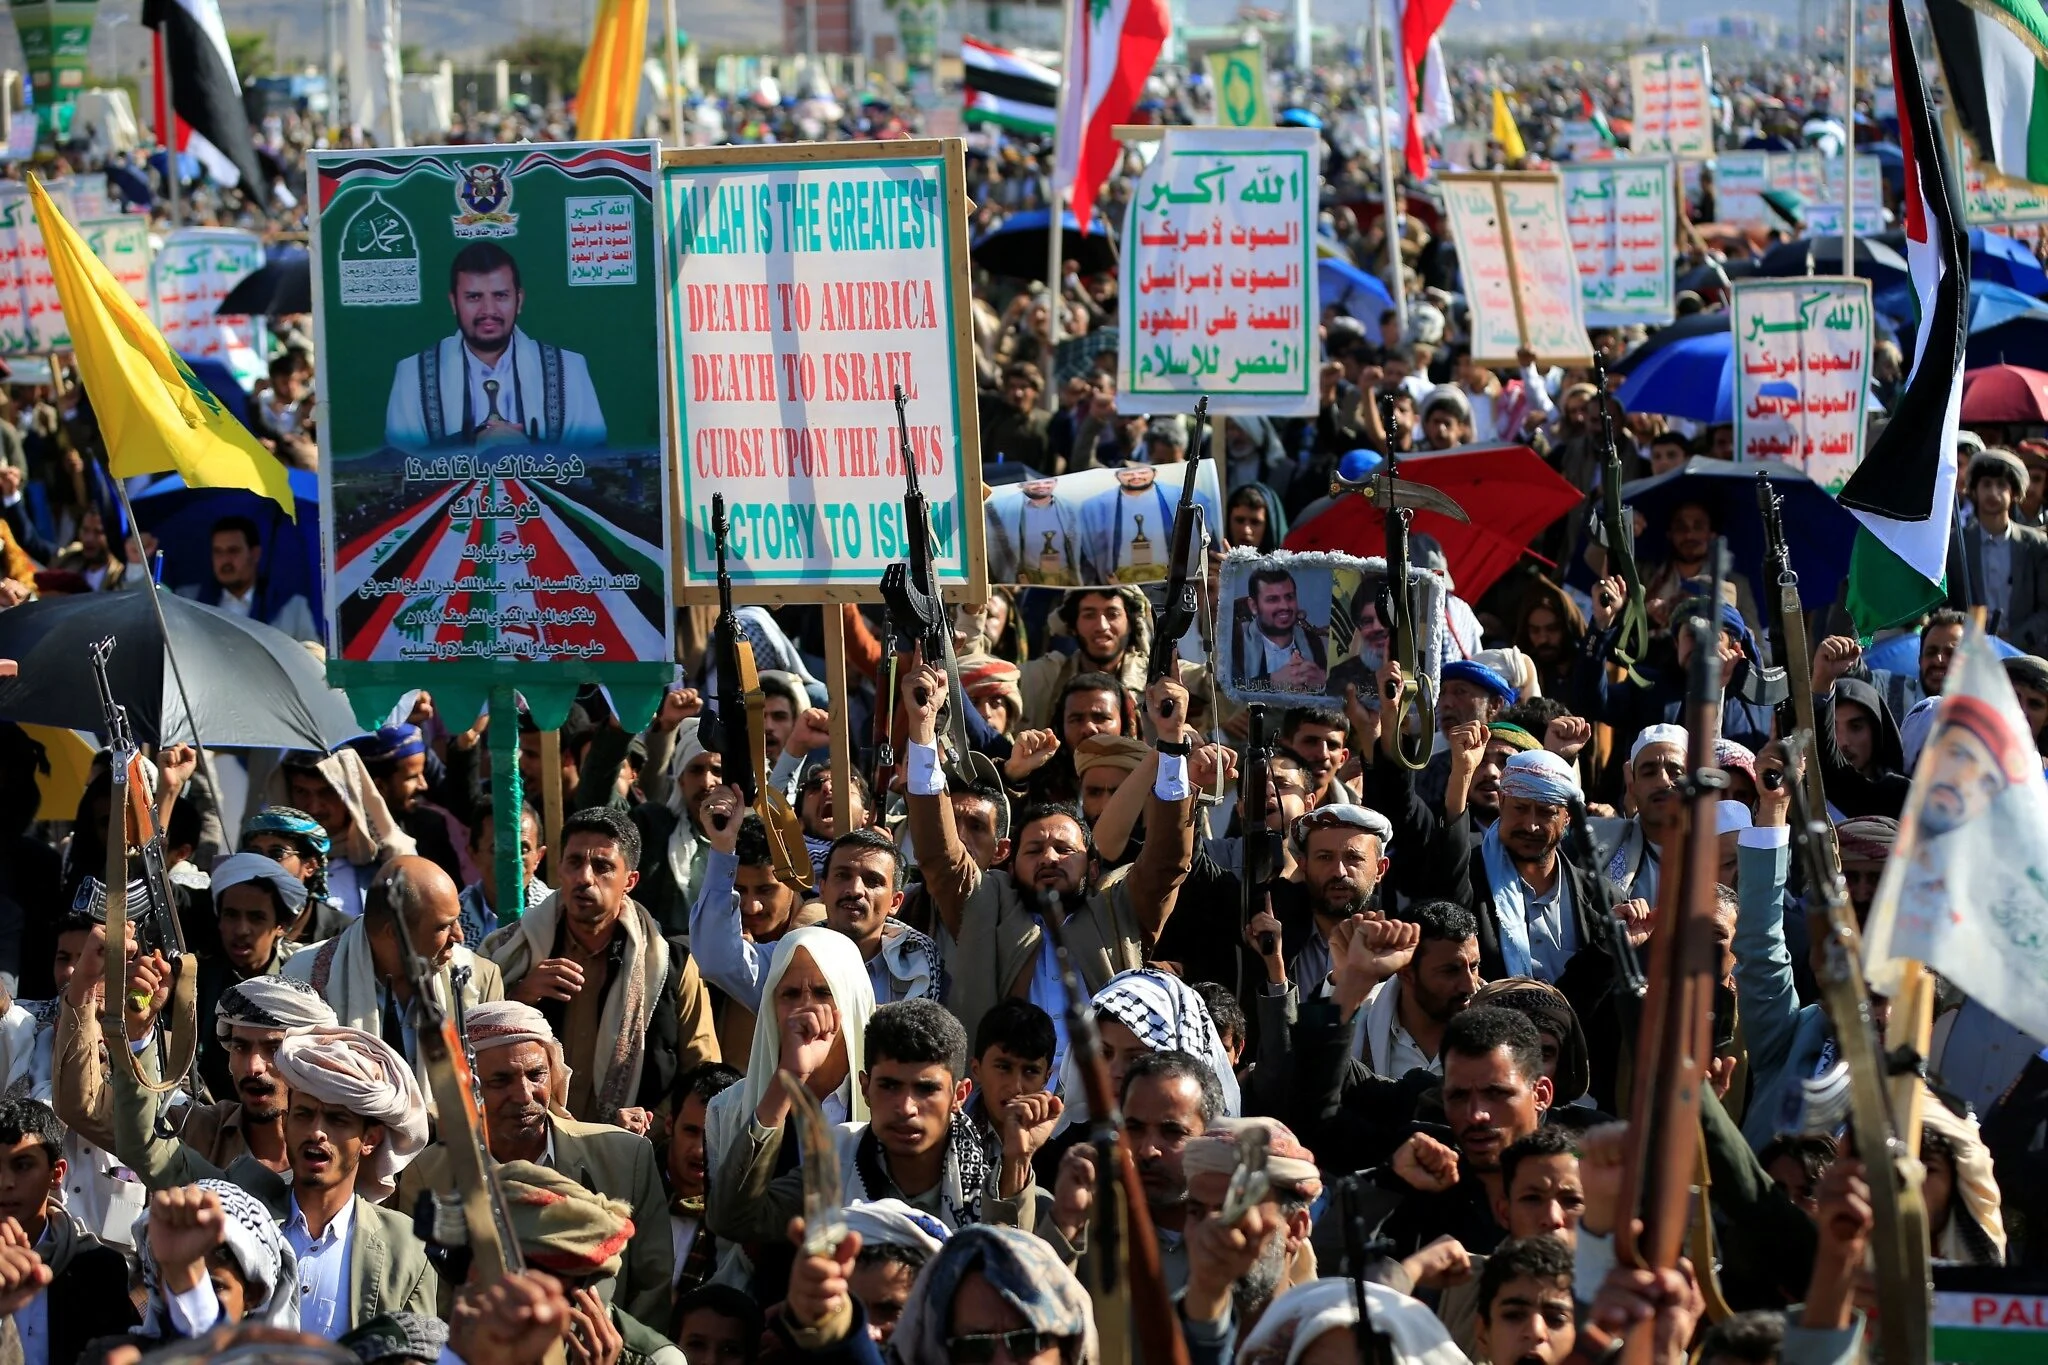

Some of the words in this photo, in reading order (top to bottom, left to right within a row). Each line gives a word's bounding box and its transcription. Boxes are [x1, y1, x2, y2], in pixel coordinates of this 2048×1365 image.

[1140, 160, 1236, 216] أكبر
[1240, 165, 1299, 205] الله
[1626, 174, 1660, 198] الله
[571, 200, 607, 219] أكبر
[608, 201, 630, 215] الله
[680, 184, 744, 255] ALLAH
[752, 184, 774, 255] IS
[777, 182, 822, 253] THE
[827, 179, 938, 253] GREATEST
[605, 221, 630, 233] الموت
[1140, 217, 1223, 252] لأمريكا
[1230, 221, 1299, 252] الموت
[605, 235, 632, 247] الموت
[572, 251, 594, 263] اليهود
[597, 251, 609, 262] على
[612, 251, 632, 260] اللعنة
[572, 266, 603, 280] للإسلام
[605, 264, 632, 279] النصر
[1139, 260, 1224, 296] لإسرائيل
[1230, 264, 1299, 295] الموت
[687, 283, 771, 333] DEATH
[777, 281, 811, 332] TO
[819, 279, 938, 332] AMERICA
[1247, 303, 1299, 330] اللعنة
[1744, 287, 1831, 347] أكبر
[1824, 294, 1864, 331] الله
[1139, 304, 1199, 337] اليهود
[1205, 305, 1239, 337] على
[1139, 342, 1220, 386] للإسلام
[1227, 340, 1299, 384] النصر
[1808, 350, 1861, 375] الموت
[692, 353, 775, 402] DEATH
[782, 352, 816, 402] TO
[822, 351, 919, 401] ISRAEL
[1808, 389, 1856, 419] الموت
[696, 427, 766, 479] CURSE
[771, 427, 829, 478] UPON
[834, 427, 880, 478] THE
[1746, 433, 1799, 462] اليهود
[1820, 430, 1854, 456] اللعنة
[493, 453, 585, 485] فوضناك
[449, 495, 541, 525] فوضناك
[823, 502, 862, 559] TO
[868, 500, 953, 559] ISLM
[359, 577, 403, 599] الحوثي
[542, 574, 574, 594] السيد
[574, 574, 607, 593] الثورة
[609, 574, 640, 590] لقائد
[443, 607, 488, 628] الشريف
[487, 607, 526, 628] النبوي
[526, 607, 557, 627] المولد
[556, 606, 597, 627] بذكرى
[539, 639, 581, 658] صاحبه
[580, 639, 606, 659] على
